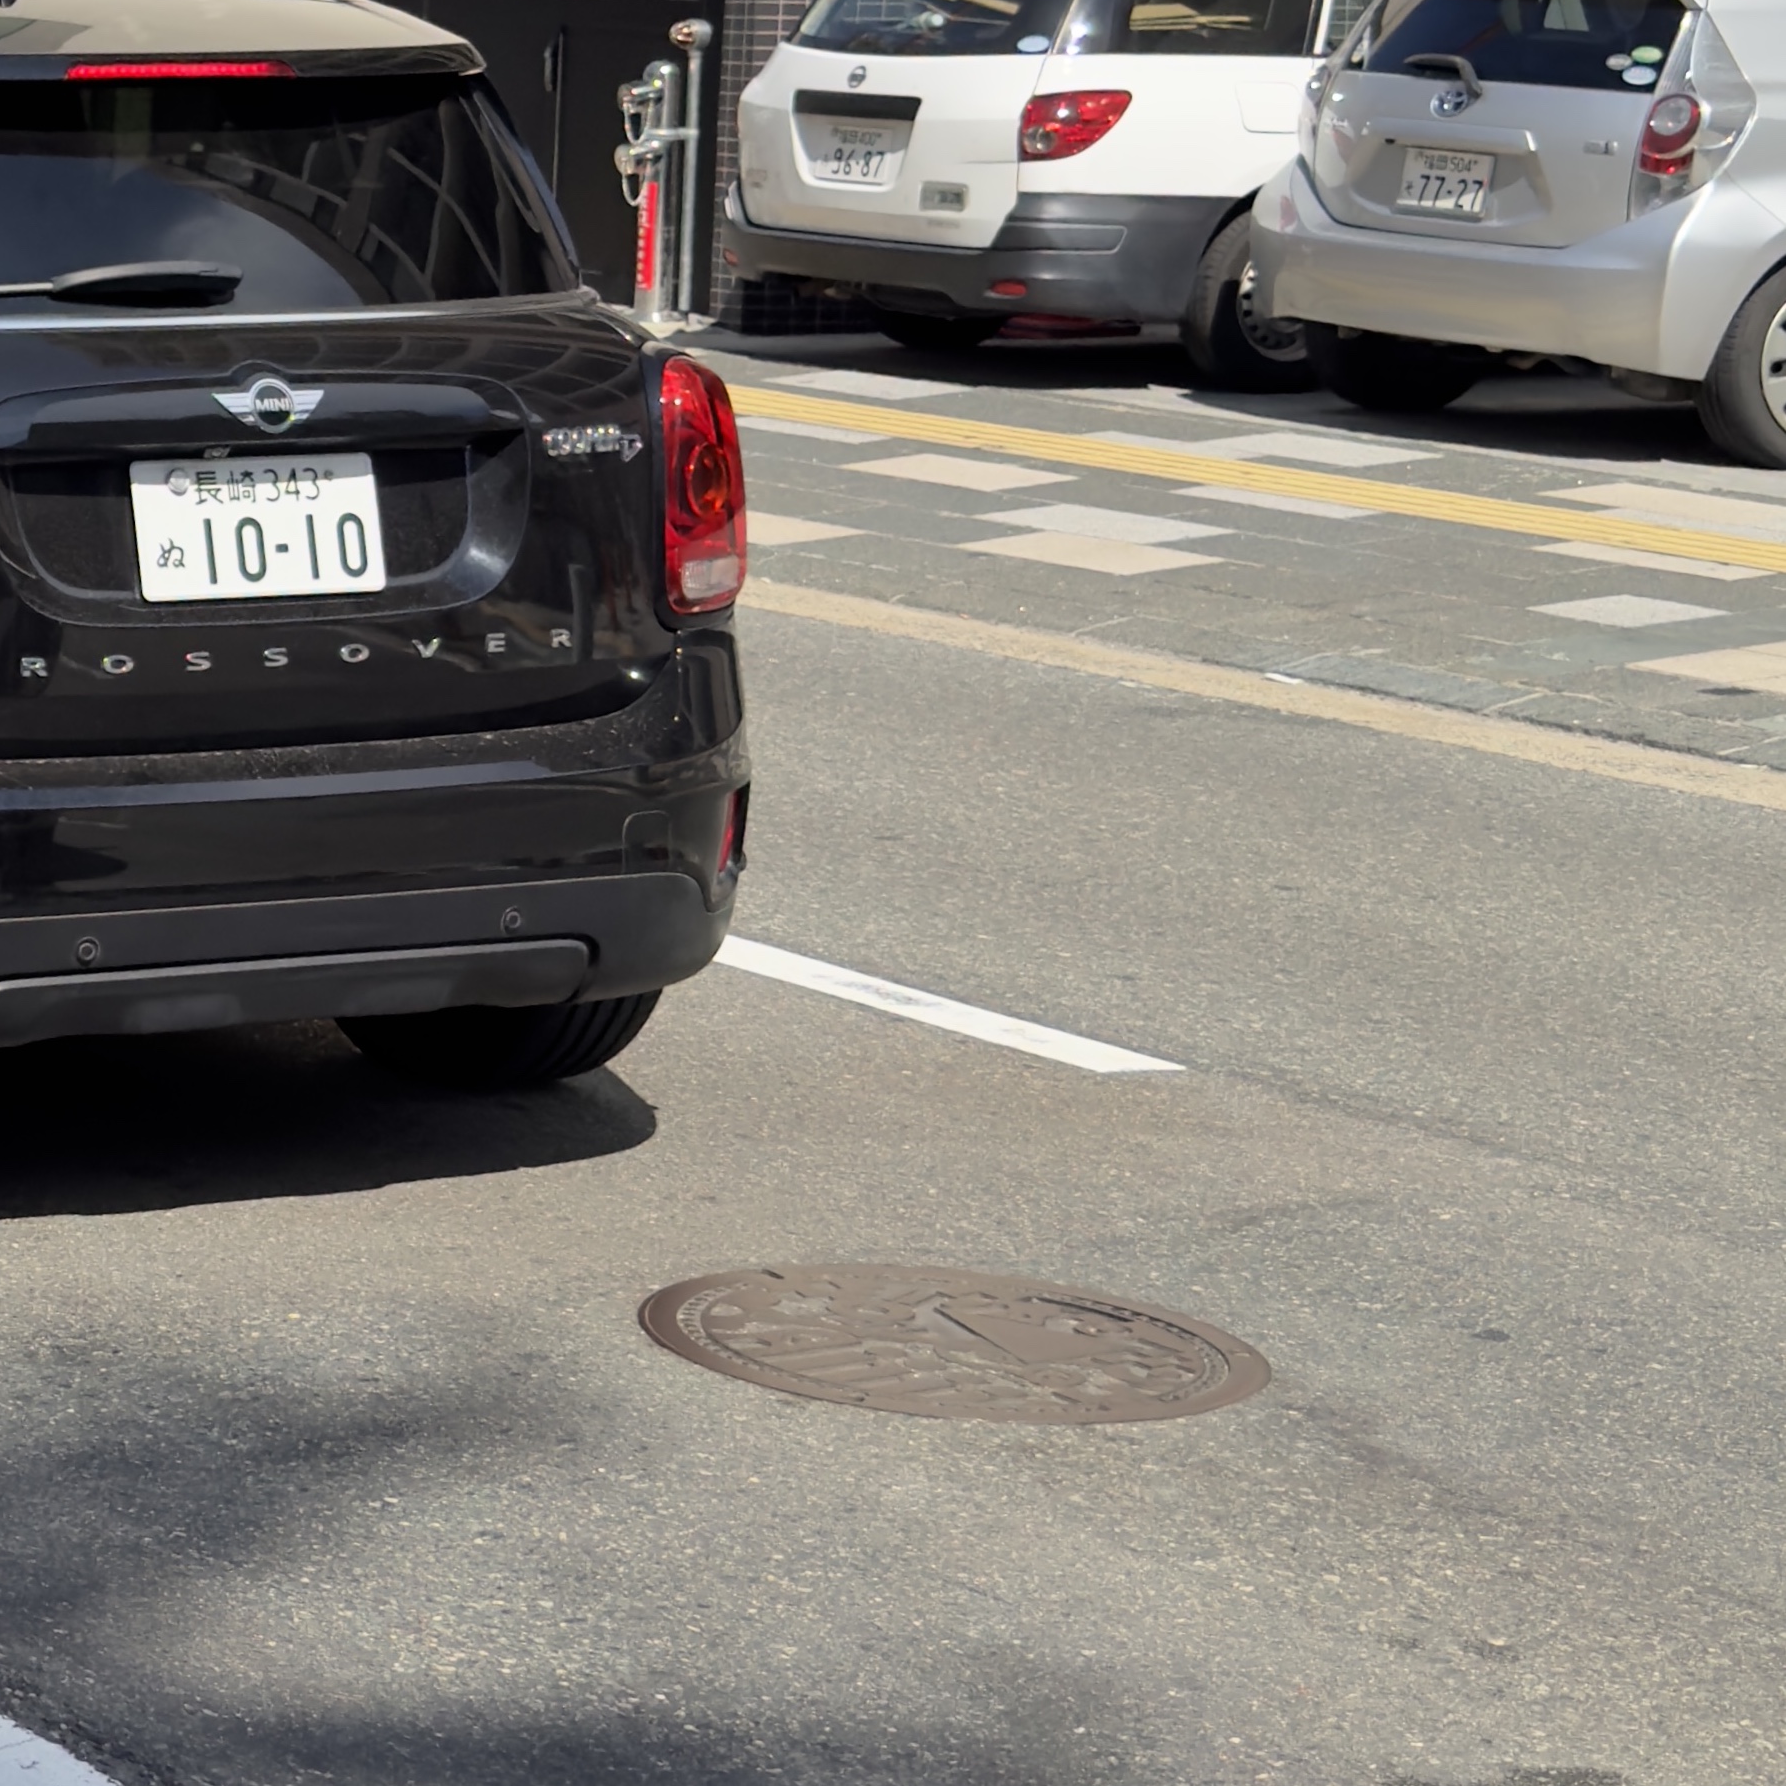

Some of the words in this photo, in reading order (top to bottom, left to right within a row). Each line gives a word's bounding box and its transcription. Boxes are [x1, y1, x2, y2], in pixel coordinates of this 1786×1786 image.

[1418, 174, 1484, 211] 77-27
[254, 397, 290, 413] MINI
[156, 538, 186, 569] ぬ
[203, 512, 369, 585] 10-10
